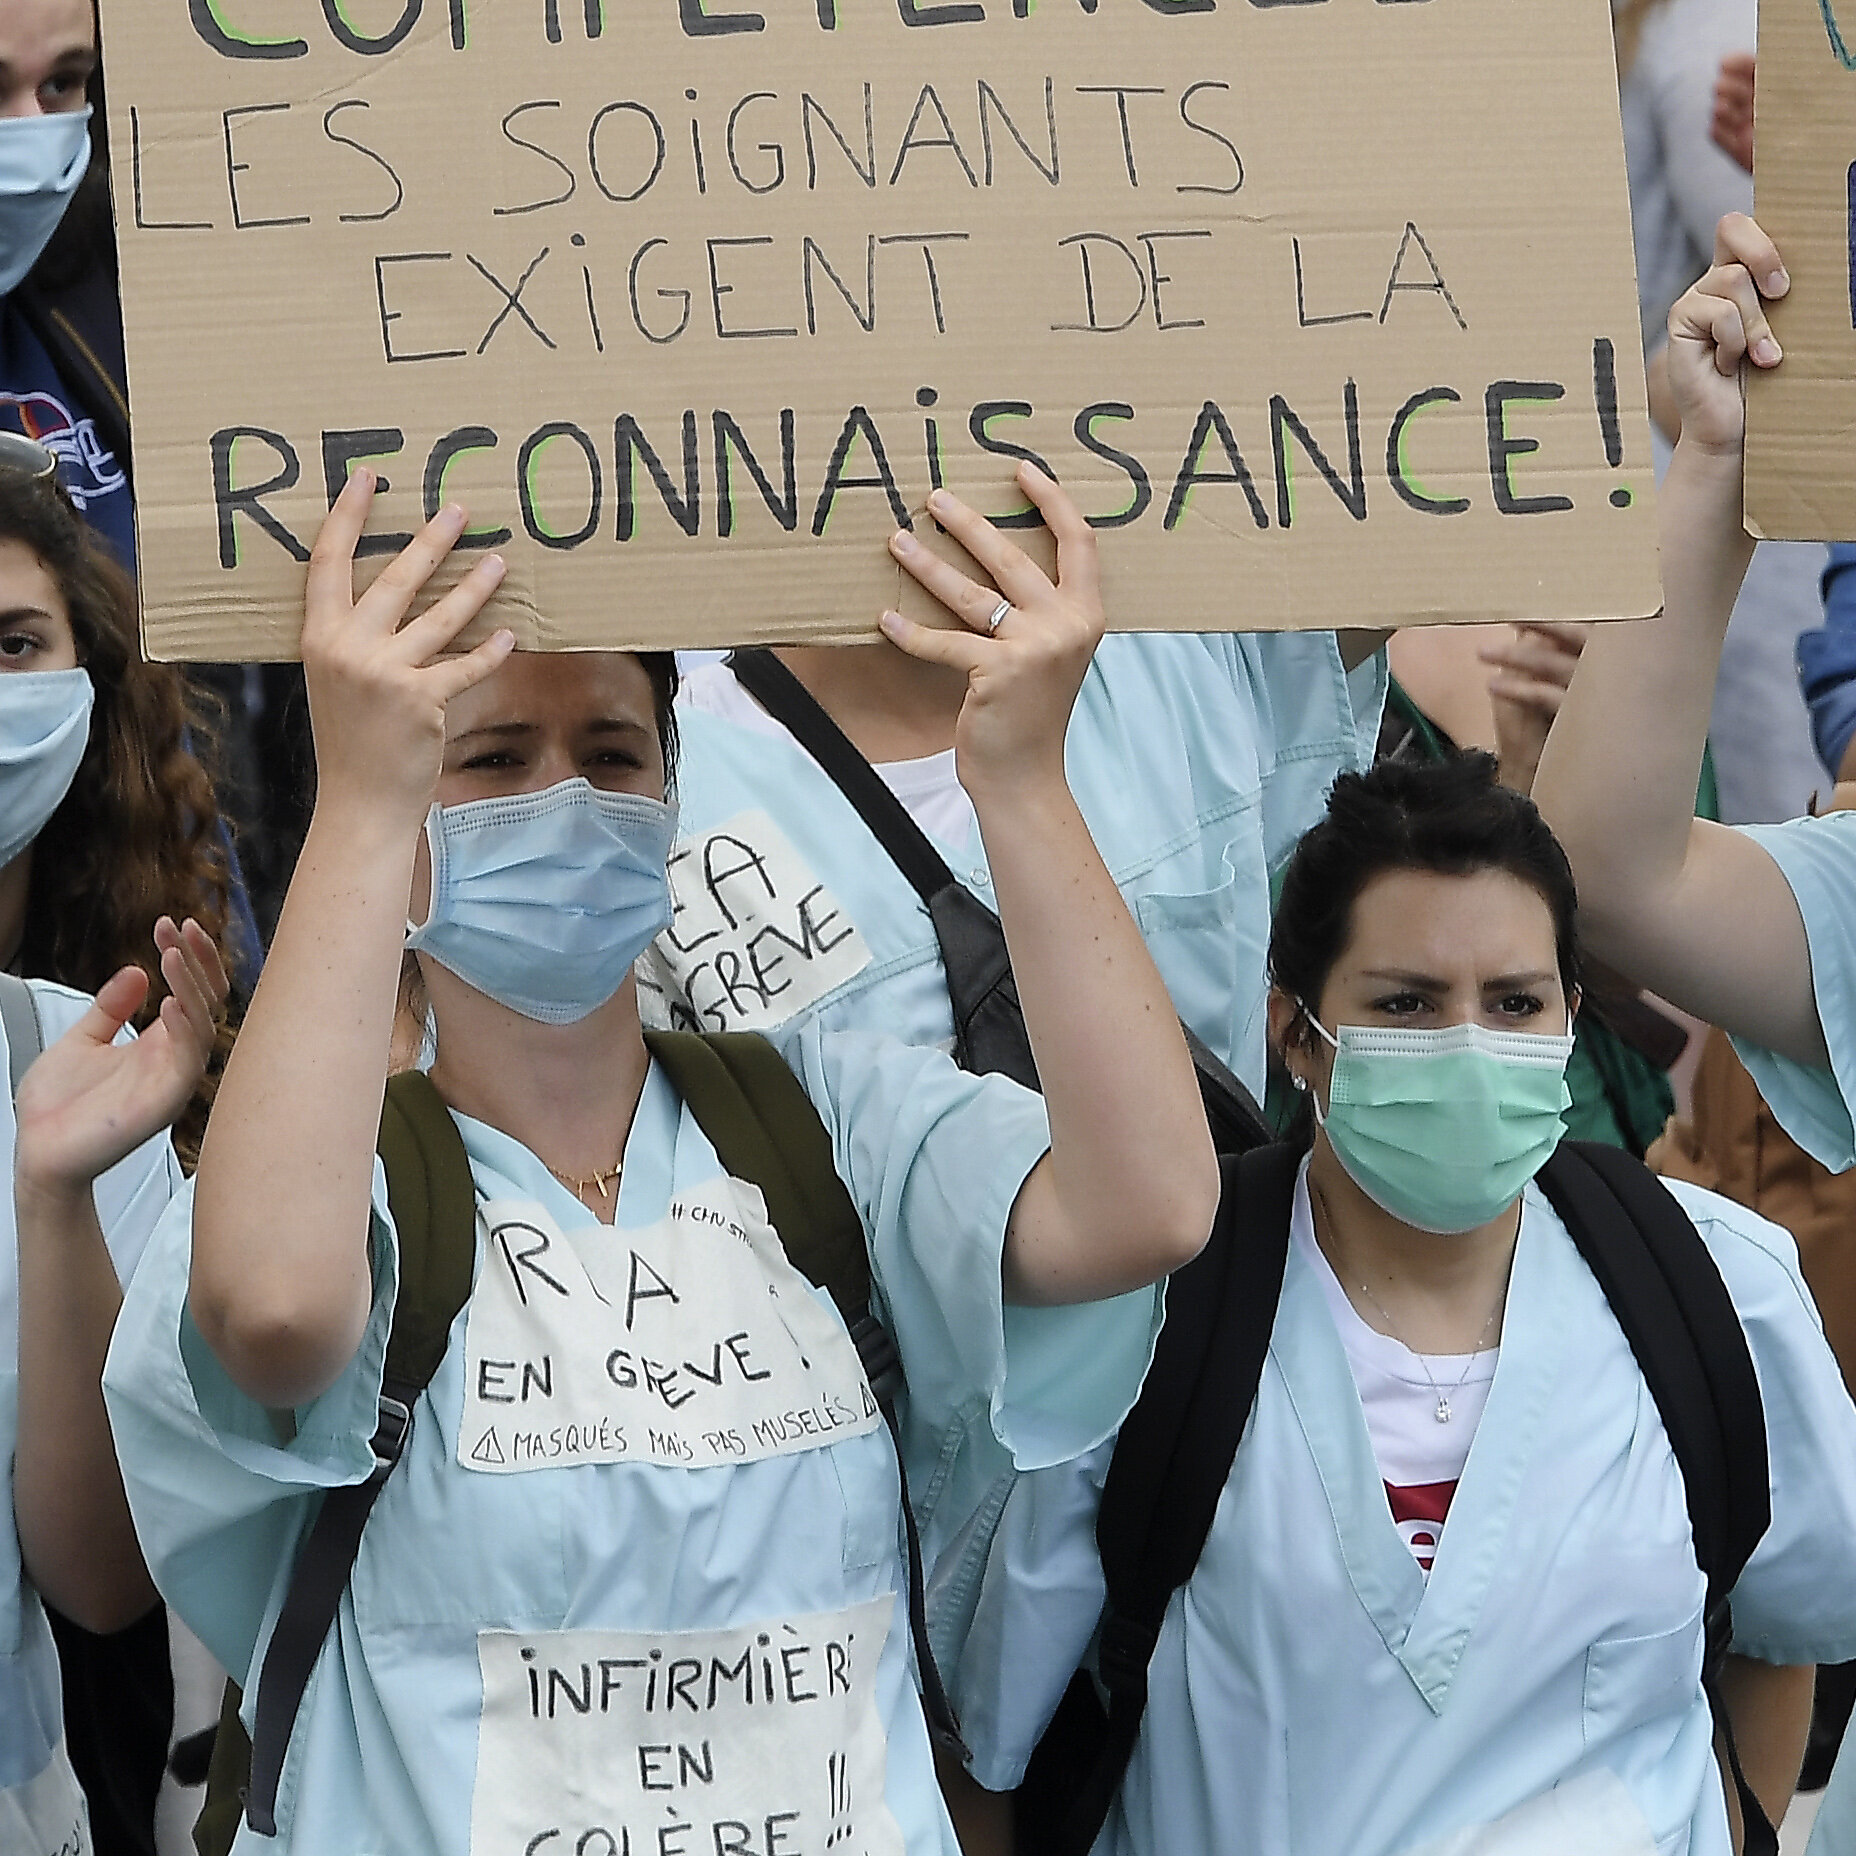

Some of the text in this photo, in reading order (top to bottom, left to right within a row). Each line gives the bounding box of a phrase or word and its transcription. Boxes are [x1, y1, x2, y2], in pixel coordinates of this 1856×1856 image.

[129, 100, 405, 231] LES
[1050, 229, 1213, 334] DE
[1291, 220, 1470, 332] LA
[477, 1355, 553, 1403] EN
[701, 1429, 746, 1456] PAS
[637, 1740, 715, 1791] EN
